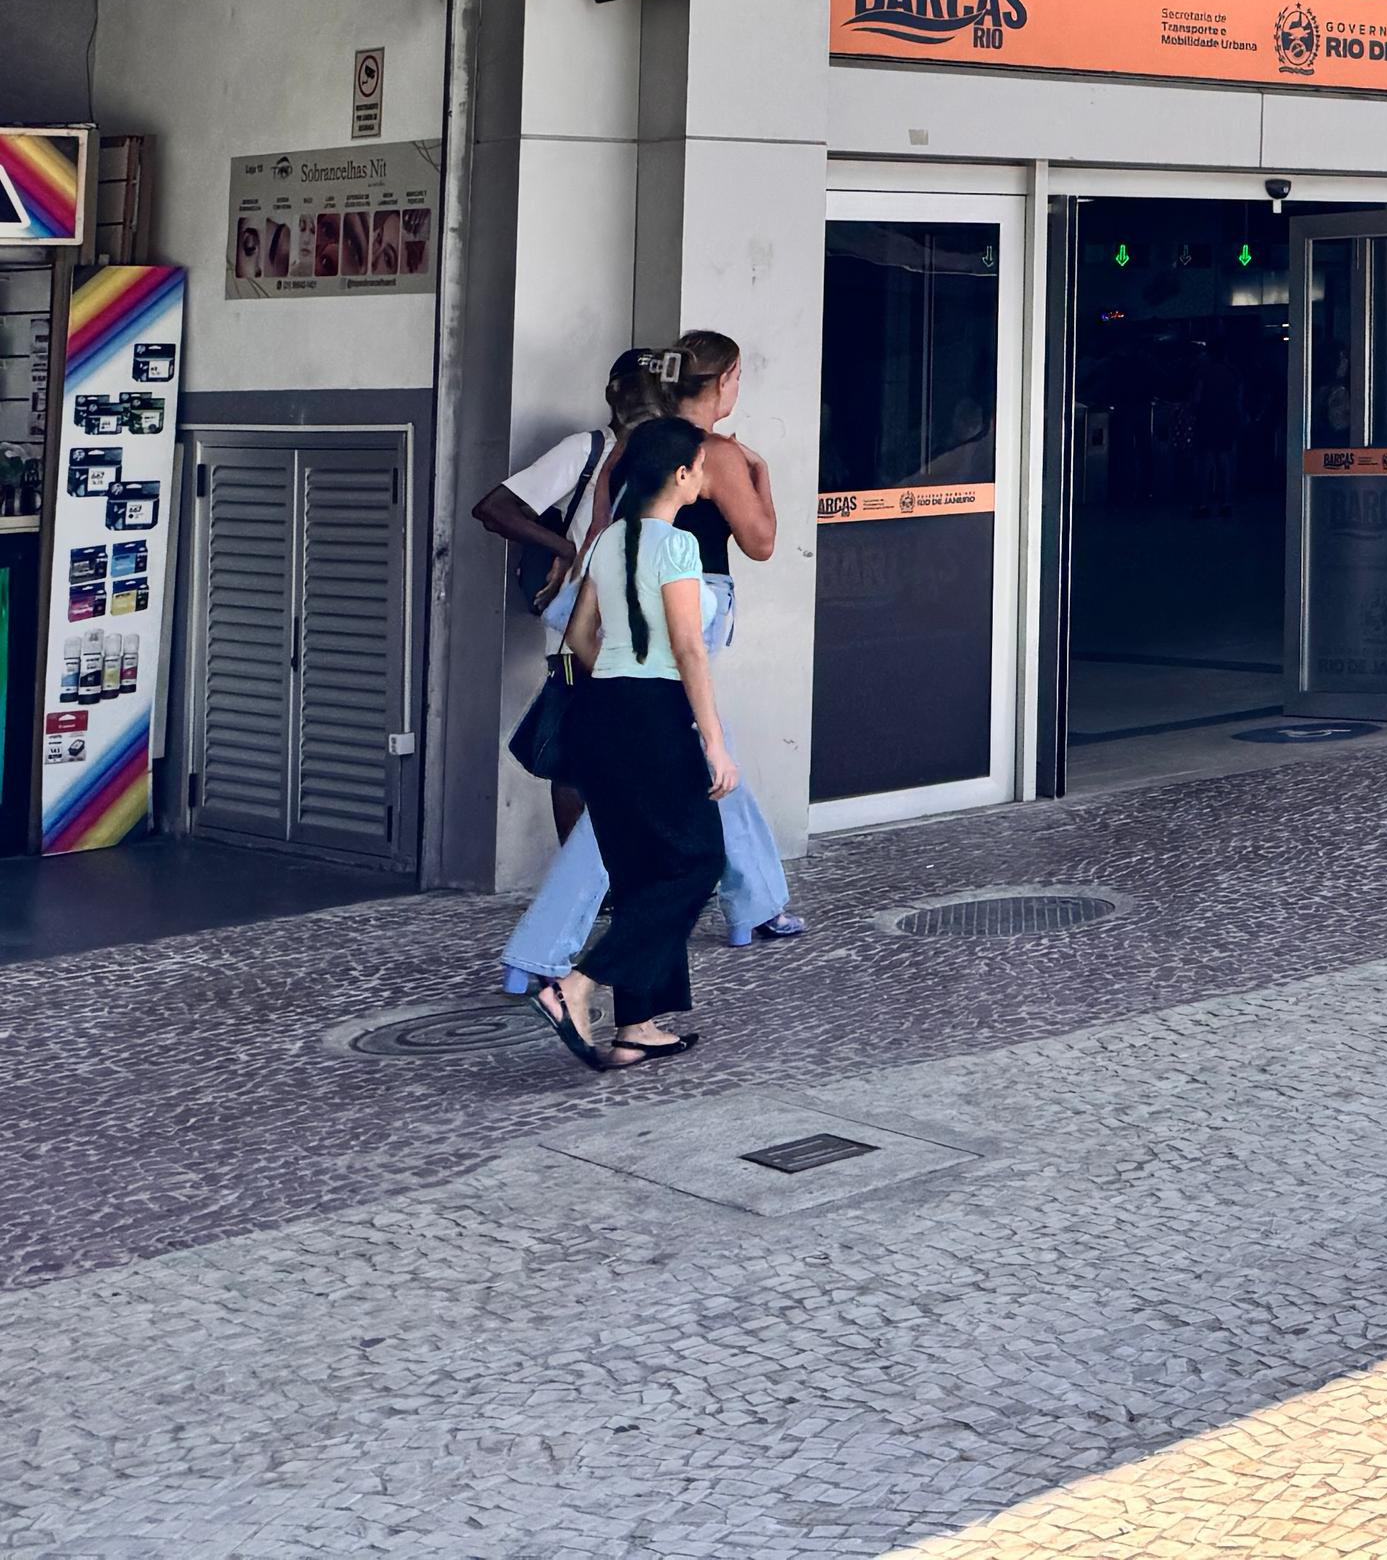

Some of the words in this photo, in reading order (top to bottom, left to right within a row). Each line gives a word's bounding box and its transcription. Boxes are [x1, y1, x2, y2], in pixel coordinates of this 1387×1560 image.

[1161, 8, 1212, 23] Secretaria
[1214, 14, 1227, 23] de
[973, 27, 1004, 49] RIO
[1161, 22, 1219, 35] Transporte
[1220, 28, 1227, 36] e
[1161, 34, 1219, 48] Mobilidade
[1221, 39, 1257, 51] Urbana
[1325, 37, 1364, 59] RIO
[301, 161, 367, 183] Sobrancelhas
[369, 158, 387, 179] Nit
[818, 496, 857, 514] ARCAS
